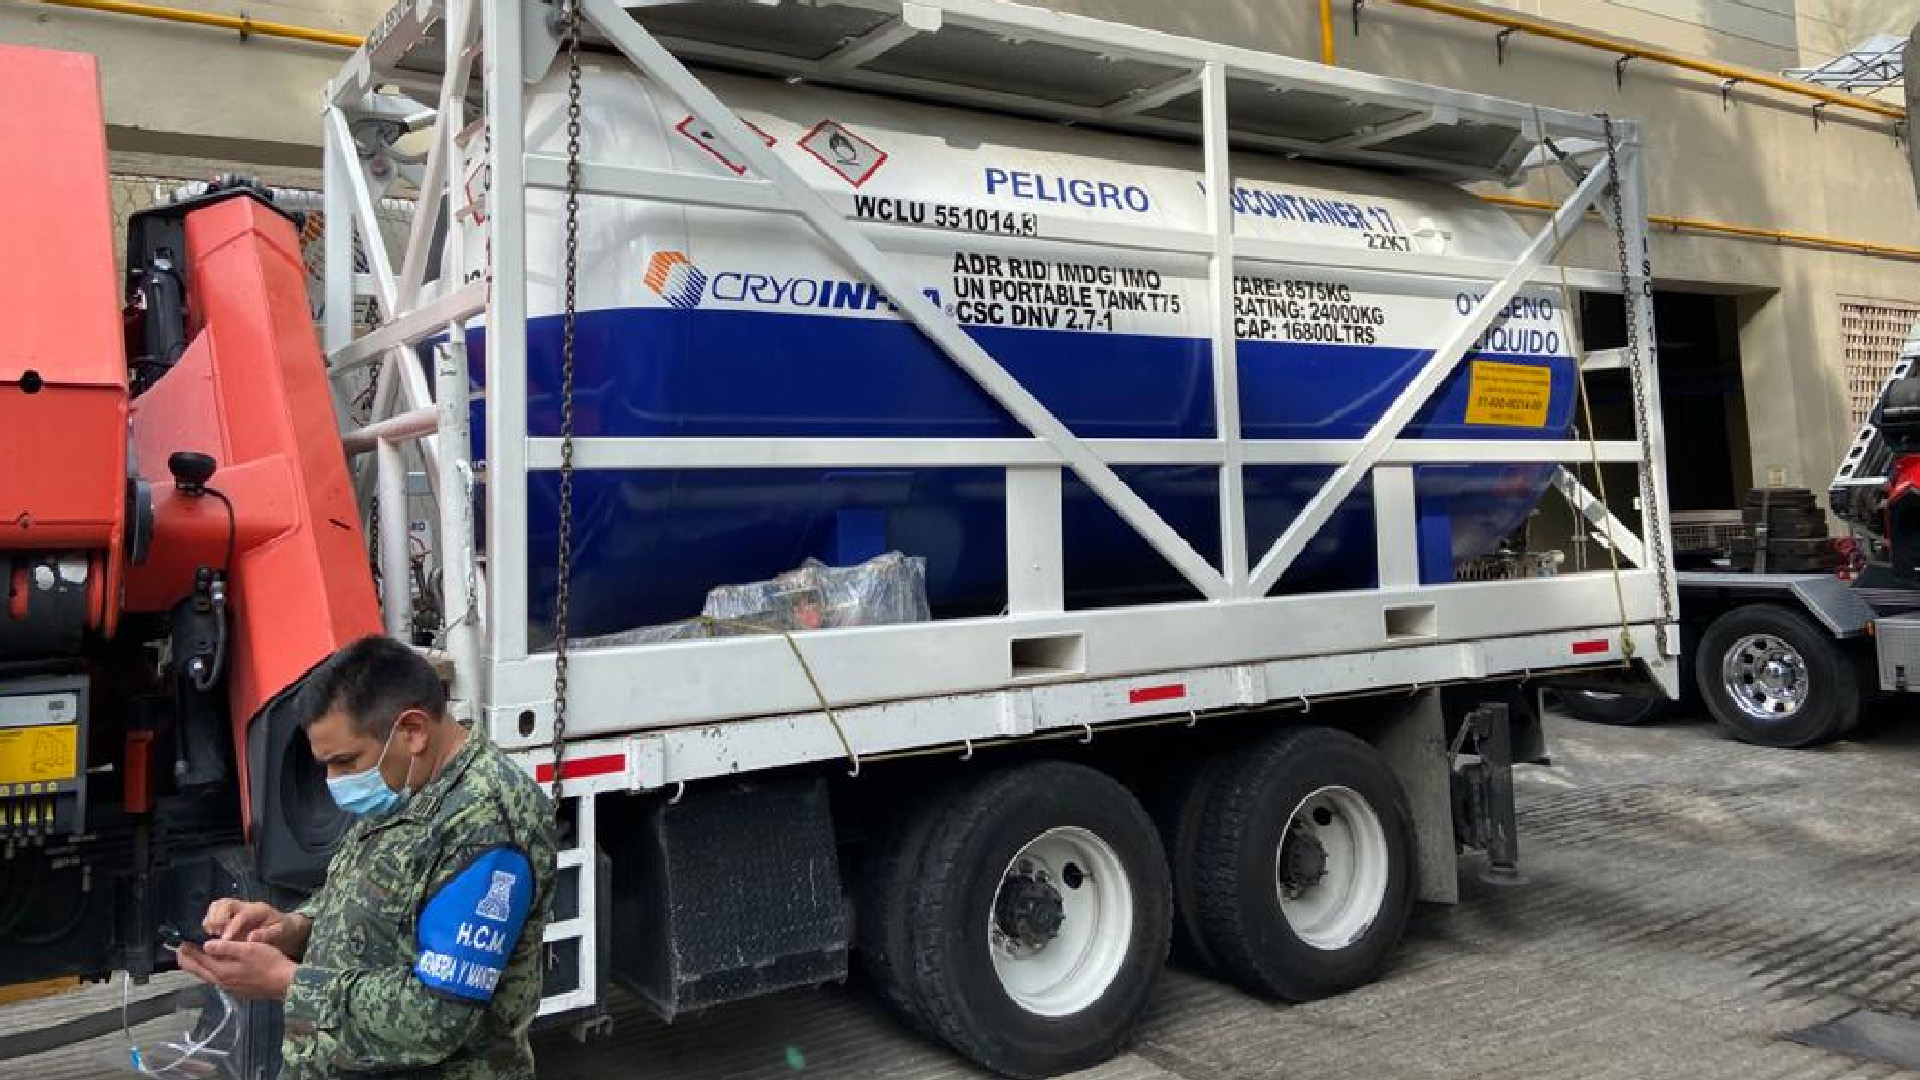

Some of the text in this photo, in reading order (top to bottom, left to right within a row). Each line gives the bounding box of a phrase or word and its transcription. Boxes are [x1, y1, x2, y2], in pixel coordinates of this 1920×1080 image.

[984, 167, 1149, 212] PELIGRO
[854, 194, 925, 223] WCLU
[1366, 206, 1397, 235] 17
[954, 252, 1003, 277] ADR
[1122, 268, 1161, 291] IMO
[954, 276, 1181, 315] UN PORTABLE TANK T75
[1234, 275, 1350, 302] TARE: 8575KG
[956, 303, 1113, 331] CSC DNV 2.7-1
[1234, 296, 1385, 325] RATING: 24000KG
[1234, 318, 1376, 345] CAP: 16800LTRS
